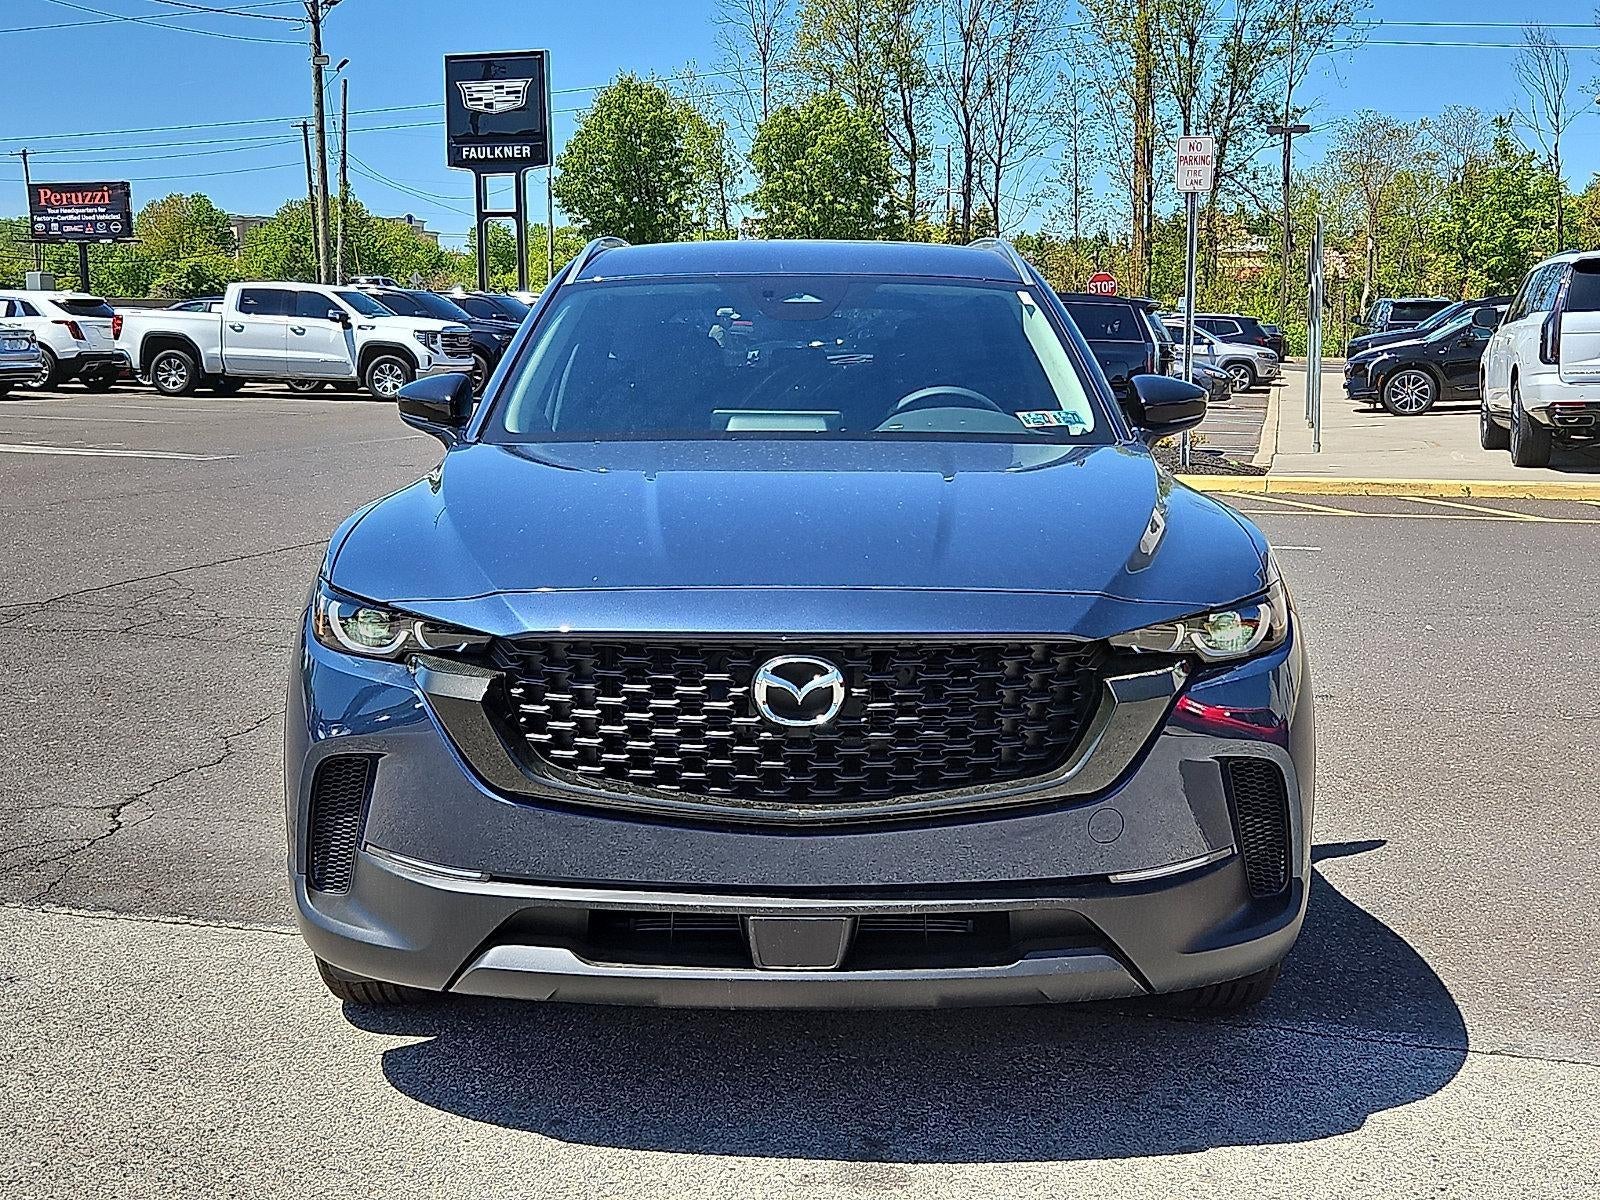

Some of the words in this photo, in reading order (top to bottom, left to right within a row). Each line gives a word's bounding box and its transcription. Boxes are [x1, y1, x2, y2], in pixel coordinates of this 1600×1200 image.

[462, 146, 531, 159] FAULKNER
[1188, 142, 1202, 152] NO
[1180, 155, 1210, 166] PARKING
[38, 186, 111, 206] Peruzzi
[1090, 280, 1115, 294] STOP
